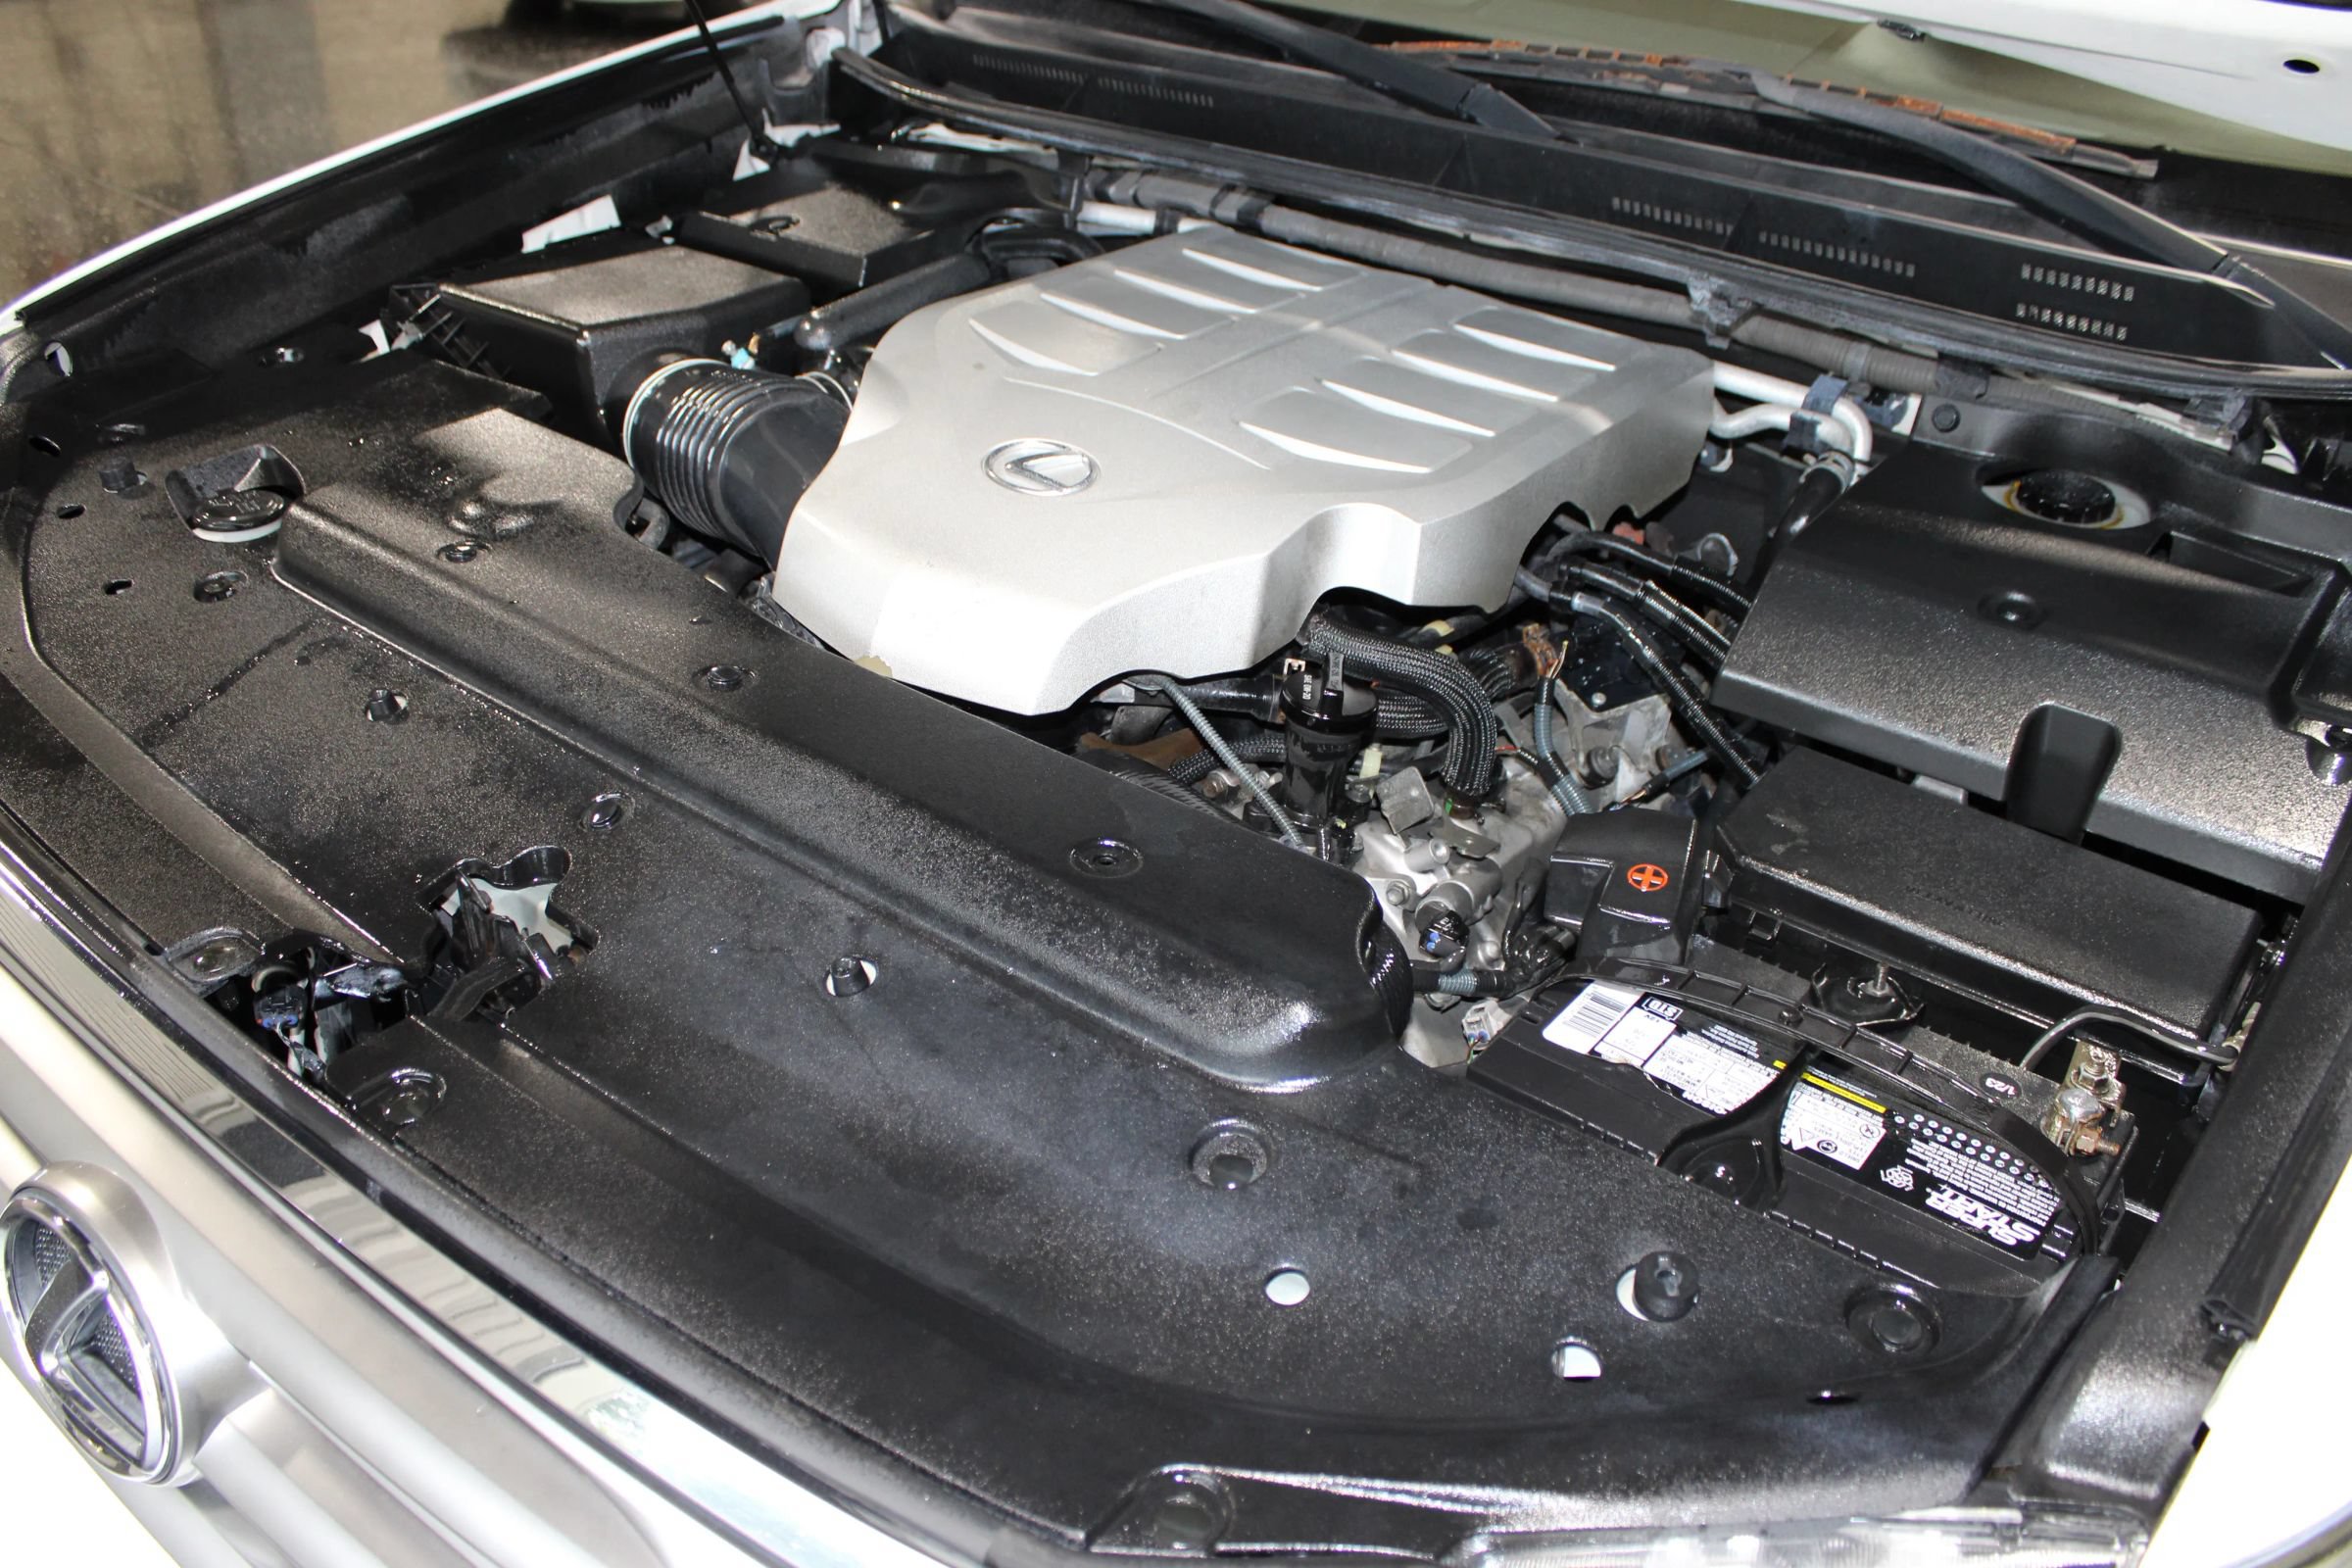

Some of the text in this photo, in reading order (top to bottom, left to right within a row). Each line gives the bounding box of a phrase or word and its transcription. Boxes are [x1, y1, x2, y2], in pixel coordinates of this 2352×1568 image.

[1303, 674, 1312, 684] SAE
[1648, 999, 1677, 1018] STD
[1925, 1197, 2018, 1246] SUPER
[1931, 1189, 2040, 1242] START
